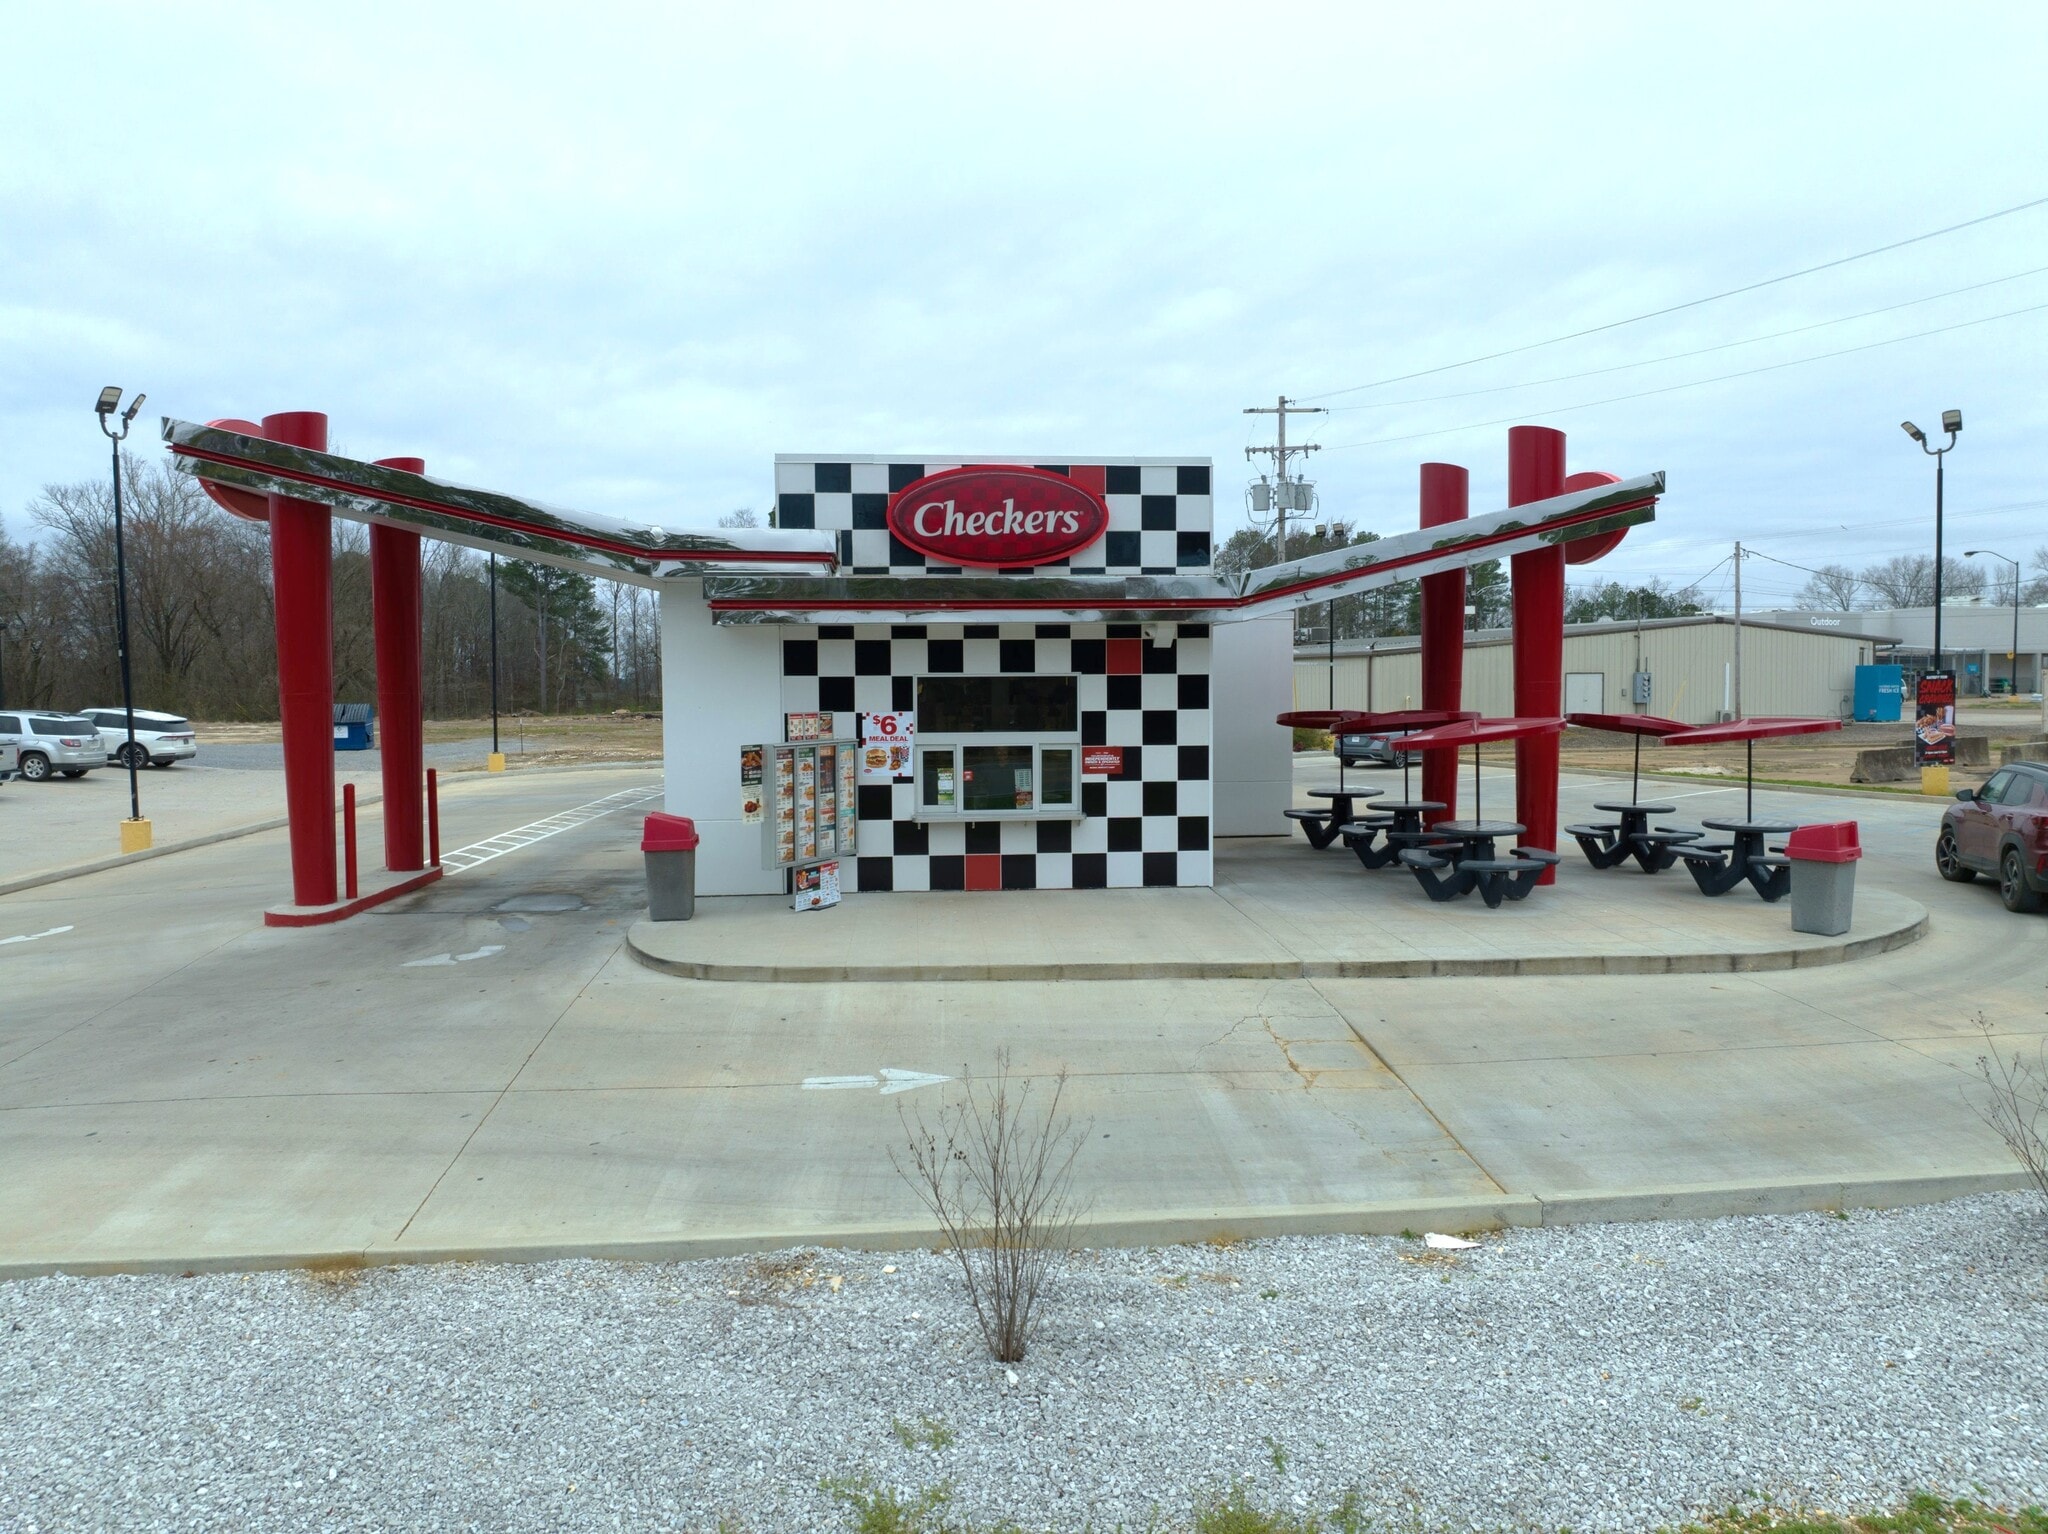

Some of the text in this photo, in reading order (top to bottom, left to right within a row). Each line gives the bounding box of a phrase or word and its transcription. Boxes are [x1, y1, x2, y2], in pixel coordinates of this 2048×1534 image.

[913, 498, 1080, 537] Checkers
[1810, 616, 1840, 626] Outdoor
[1919, 679, 1953, 693] SNACK
[873, 715, 897, 735] $6
